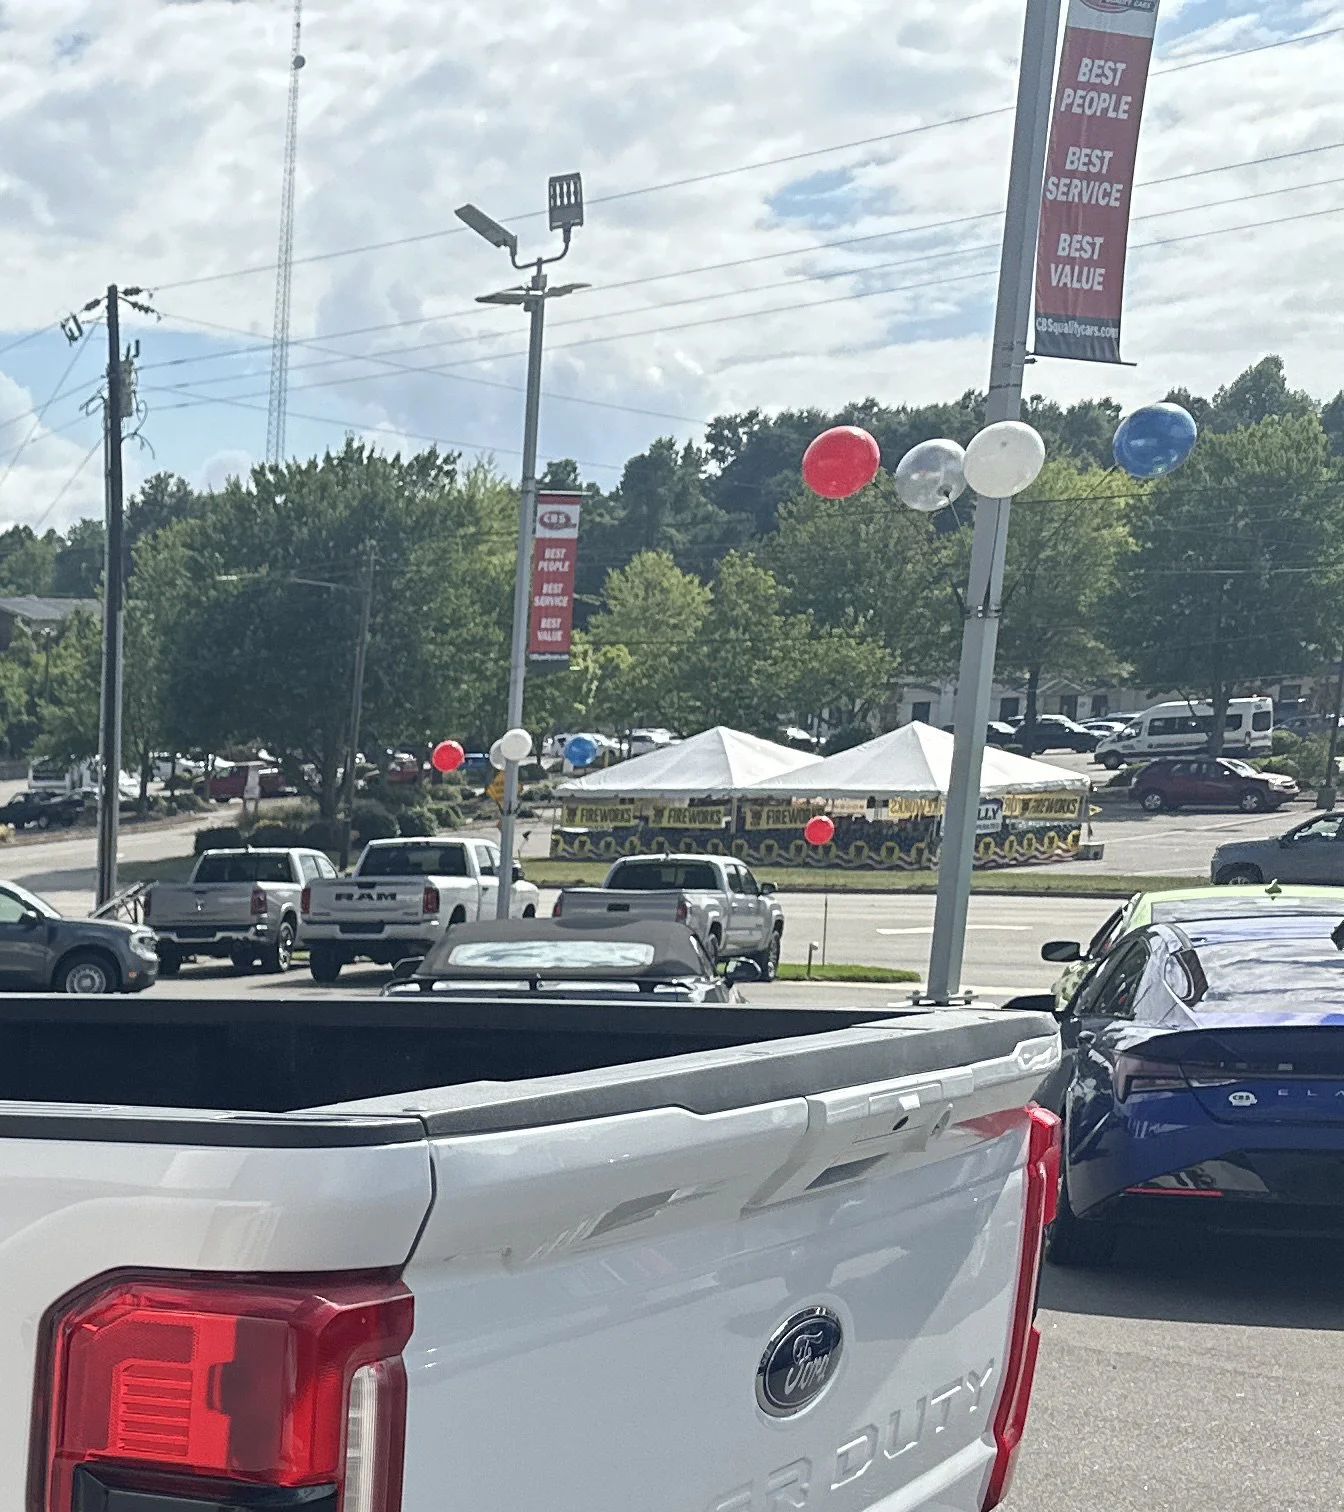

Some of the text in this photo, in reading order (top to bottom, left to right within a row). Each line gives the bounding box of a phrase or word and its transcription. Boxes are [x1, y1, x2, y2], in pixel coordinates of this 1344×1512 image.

[1077, 57, 1126, 87] BEST
[1060, 88, 1131, 120] PEOPLE
[1065, 146, 1113, 174] BEST
[1045, 176, 1123, 207] SERVICE
[1056, 233, 1104, 260] BEST
[1050, 263, 1105, 291] VALUE
[544, 548, 567, 559] BEST
[538, 560, 569, 572] PEOPLE
[542, 583, 563, 594] BEST
[533, 595, 568, 607] SERVICE
[540, 617, 562, 629] BEST
[537, 630, 563, 641] VALUE
[580, 806, 632, 824] FIREWORKS
[668, 806, 722, 825] FIREWORKS
[335, 893, 397, 901] RAM
[784, 1330, 830, 1396] Ford
[829, 1357, 995, 1491] DUTY
